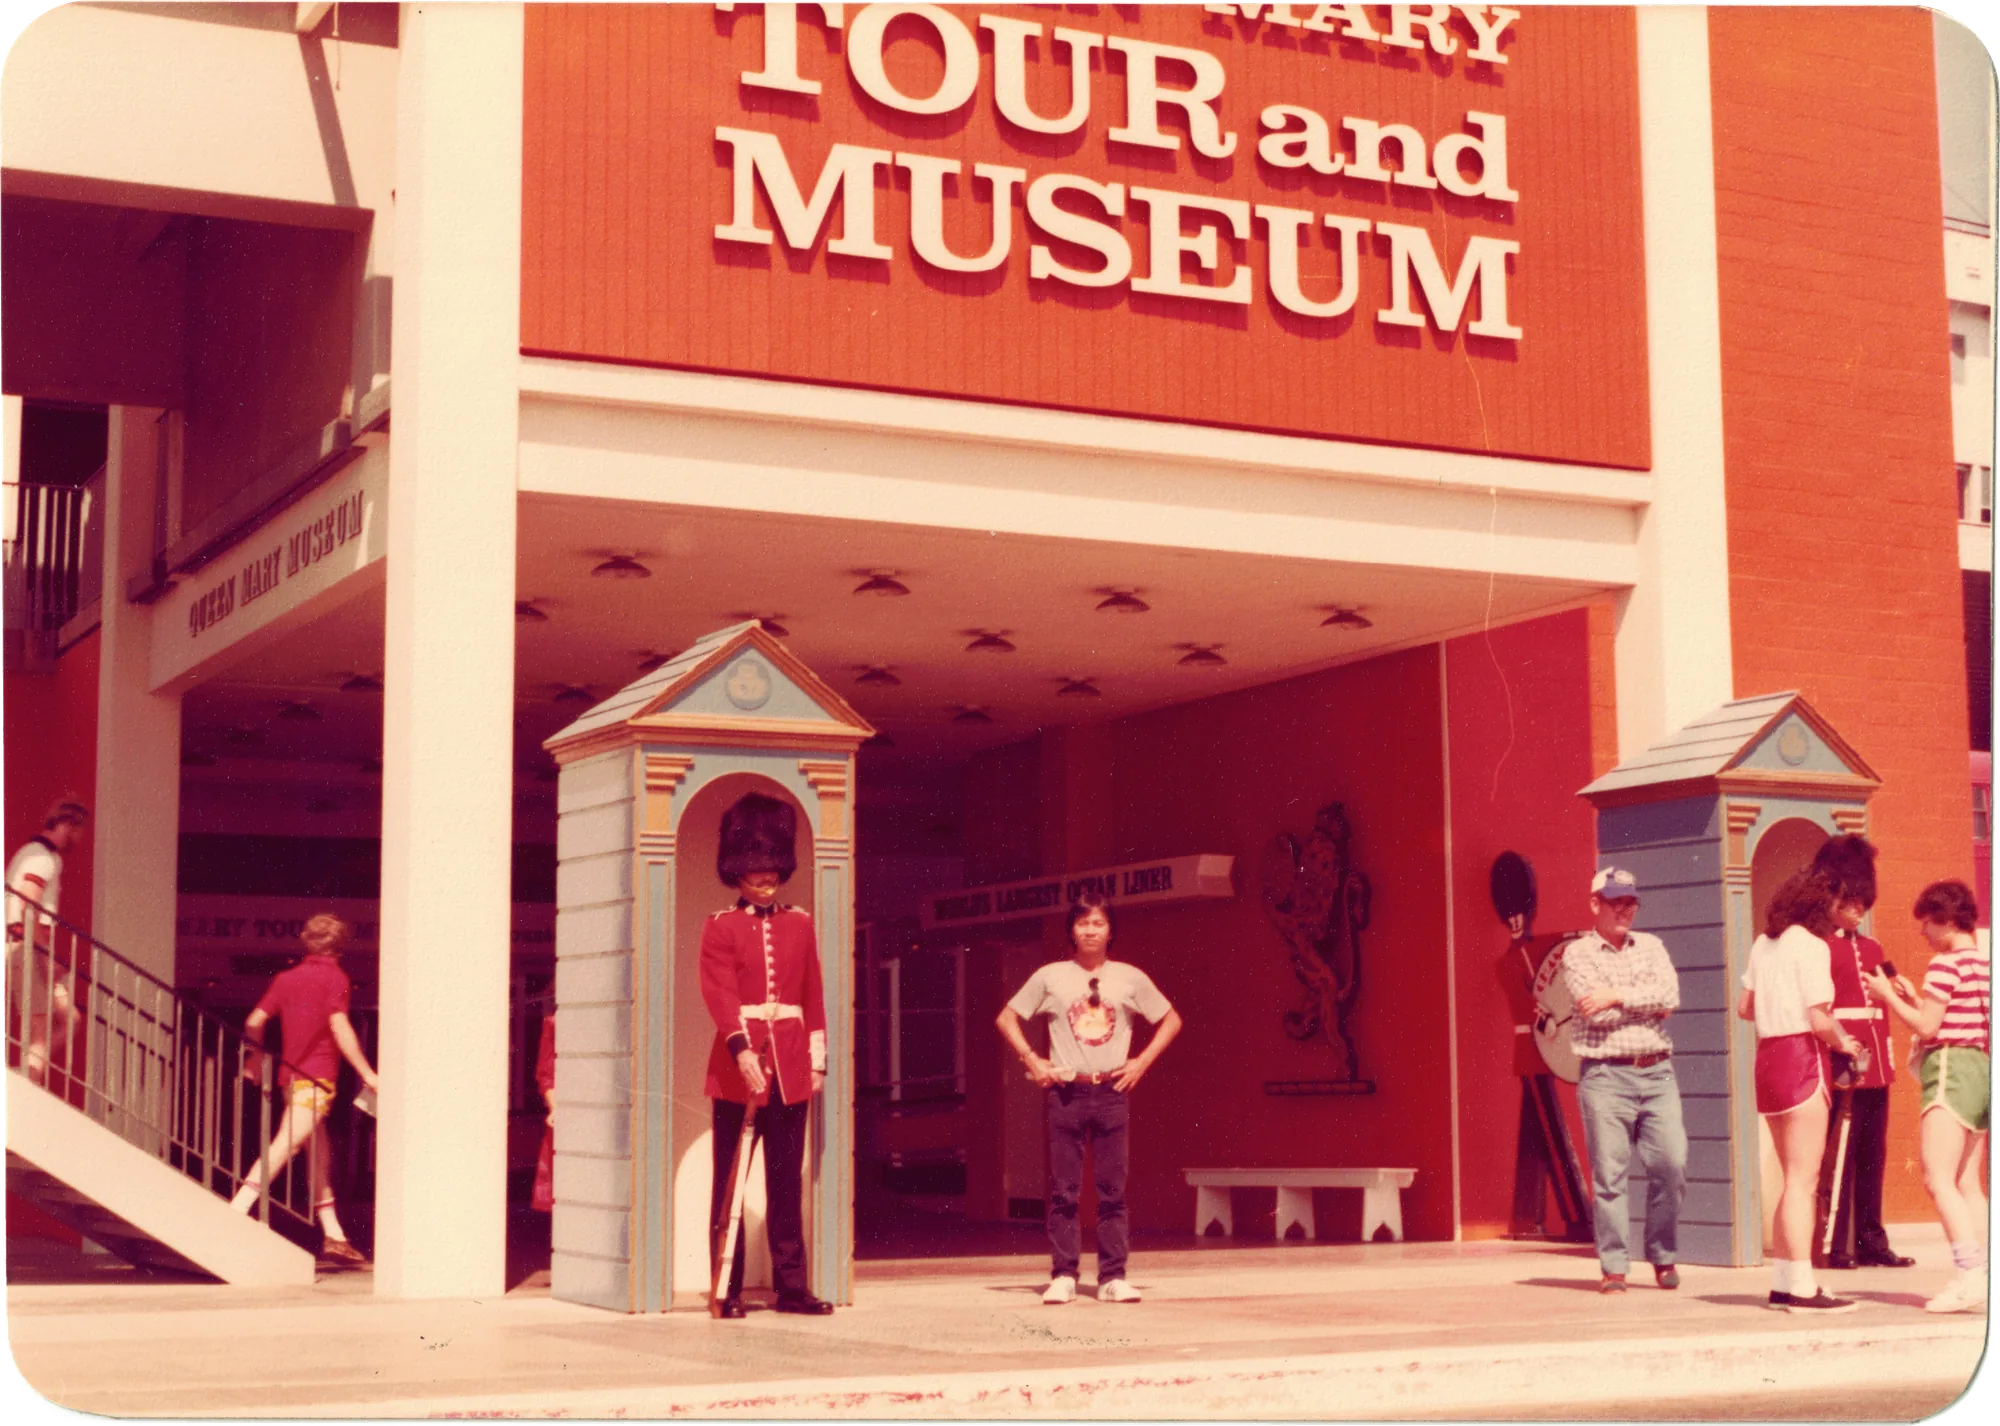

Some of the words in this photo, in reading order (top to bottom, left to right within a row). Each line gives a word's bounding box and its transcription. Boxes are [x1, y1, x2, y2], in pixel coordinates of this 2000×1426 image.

[715, 3, 1237, 158] TOUR
[1257, 110, 1519, 202] and
[714, 126, 1522, 340] MUSEUM
[189, 575, 236, 638] QUEEN
[240, 545, 282, 607] MARY
[287, 489, 364, 578] MUSEUM
[1123, 866, 1173, 895] LINER
